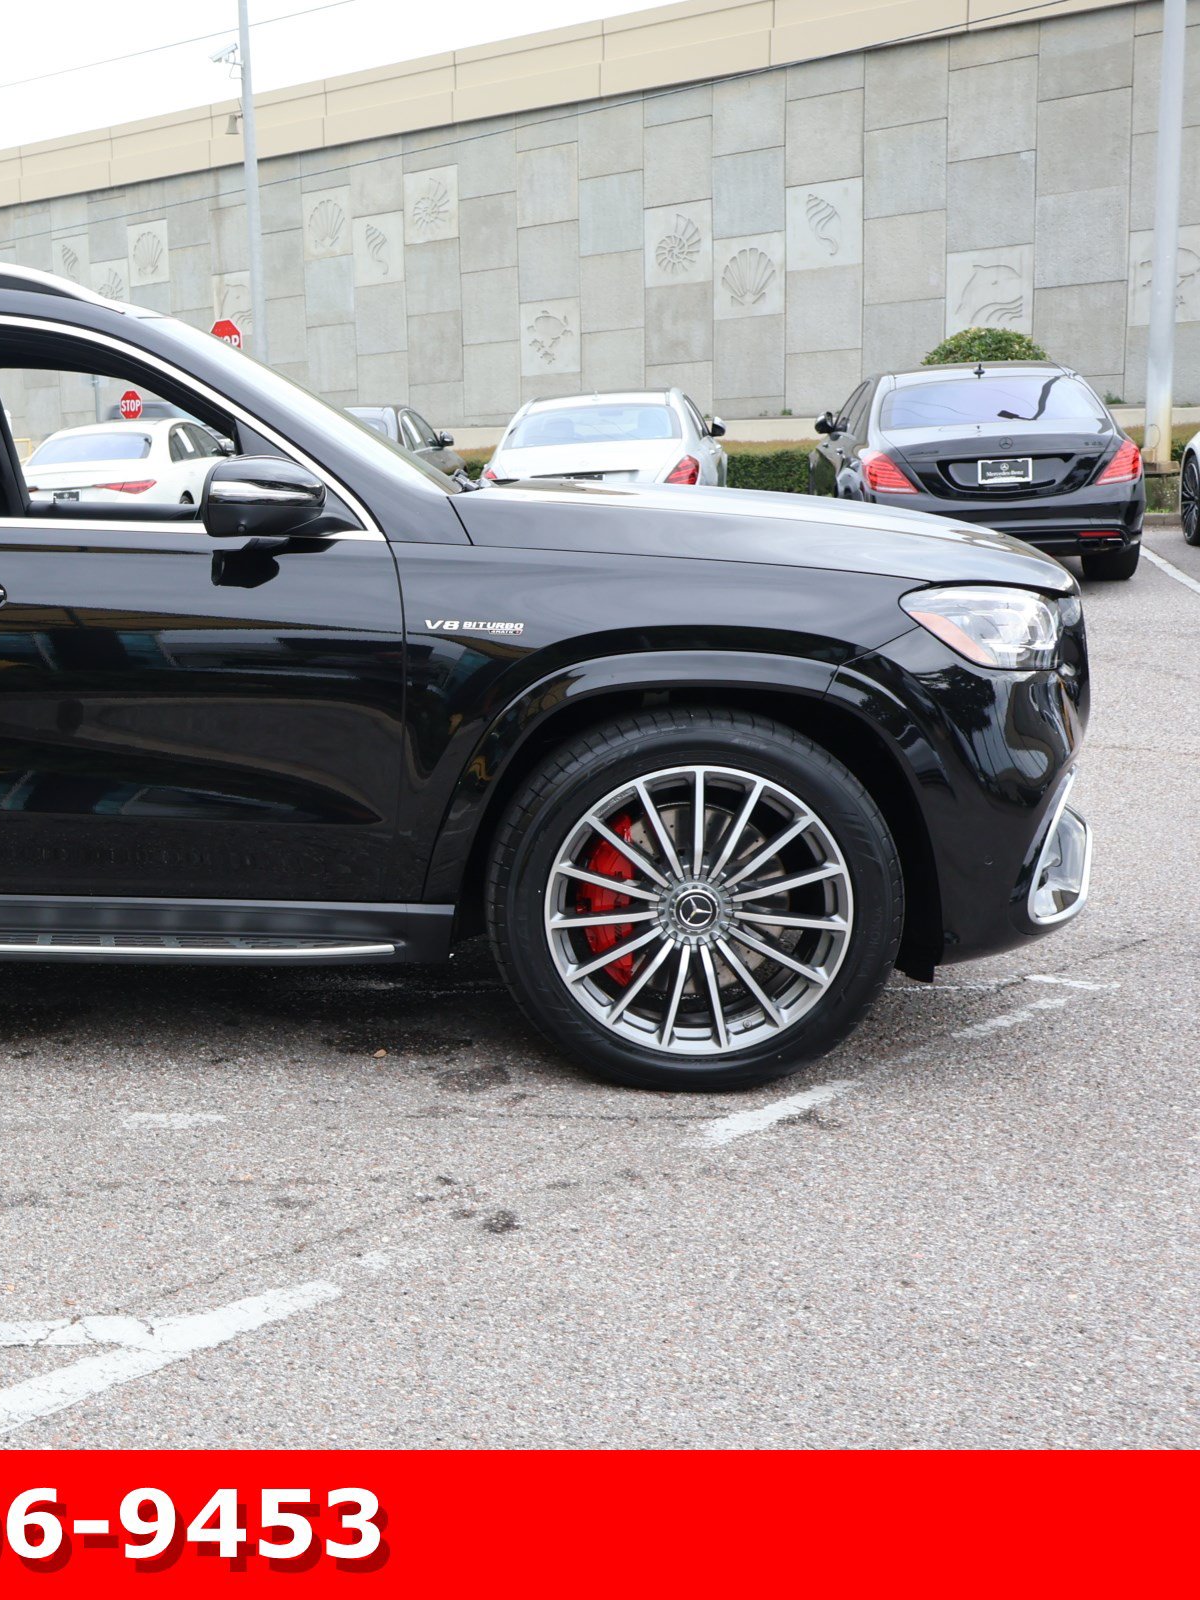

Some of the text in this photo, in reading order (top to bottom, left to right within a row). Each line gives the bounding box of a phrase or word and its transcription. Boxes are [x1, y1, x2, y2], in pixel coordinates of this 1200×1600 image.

[121, 399, 141, 412] STOP
[425, 620, 525, 630] V8 BITURBO
